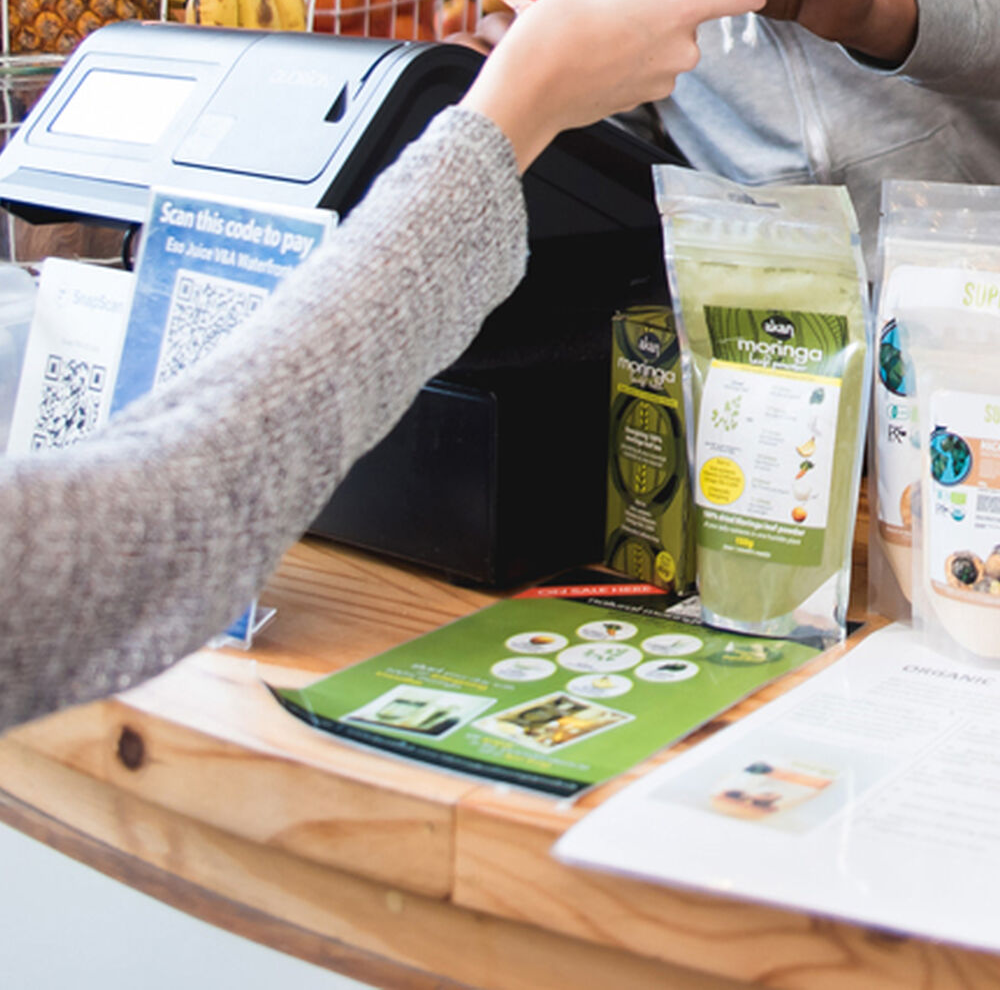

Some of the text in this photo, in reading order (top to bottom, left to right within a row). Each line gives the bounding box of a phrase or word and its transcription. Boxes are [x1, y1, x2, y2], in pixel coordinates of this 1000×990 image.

[159, 201, 315, 259] Scan this code to pay
[737, 339, 823, 365] moringa
[617, 357, 676, 386] moringa
[902, 664, 996, 686] ORGANIC
